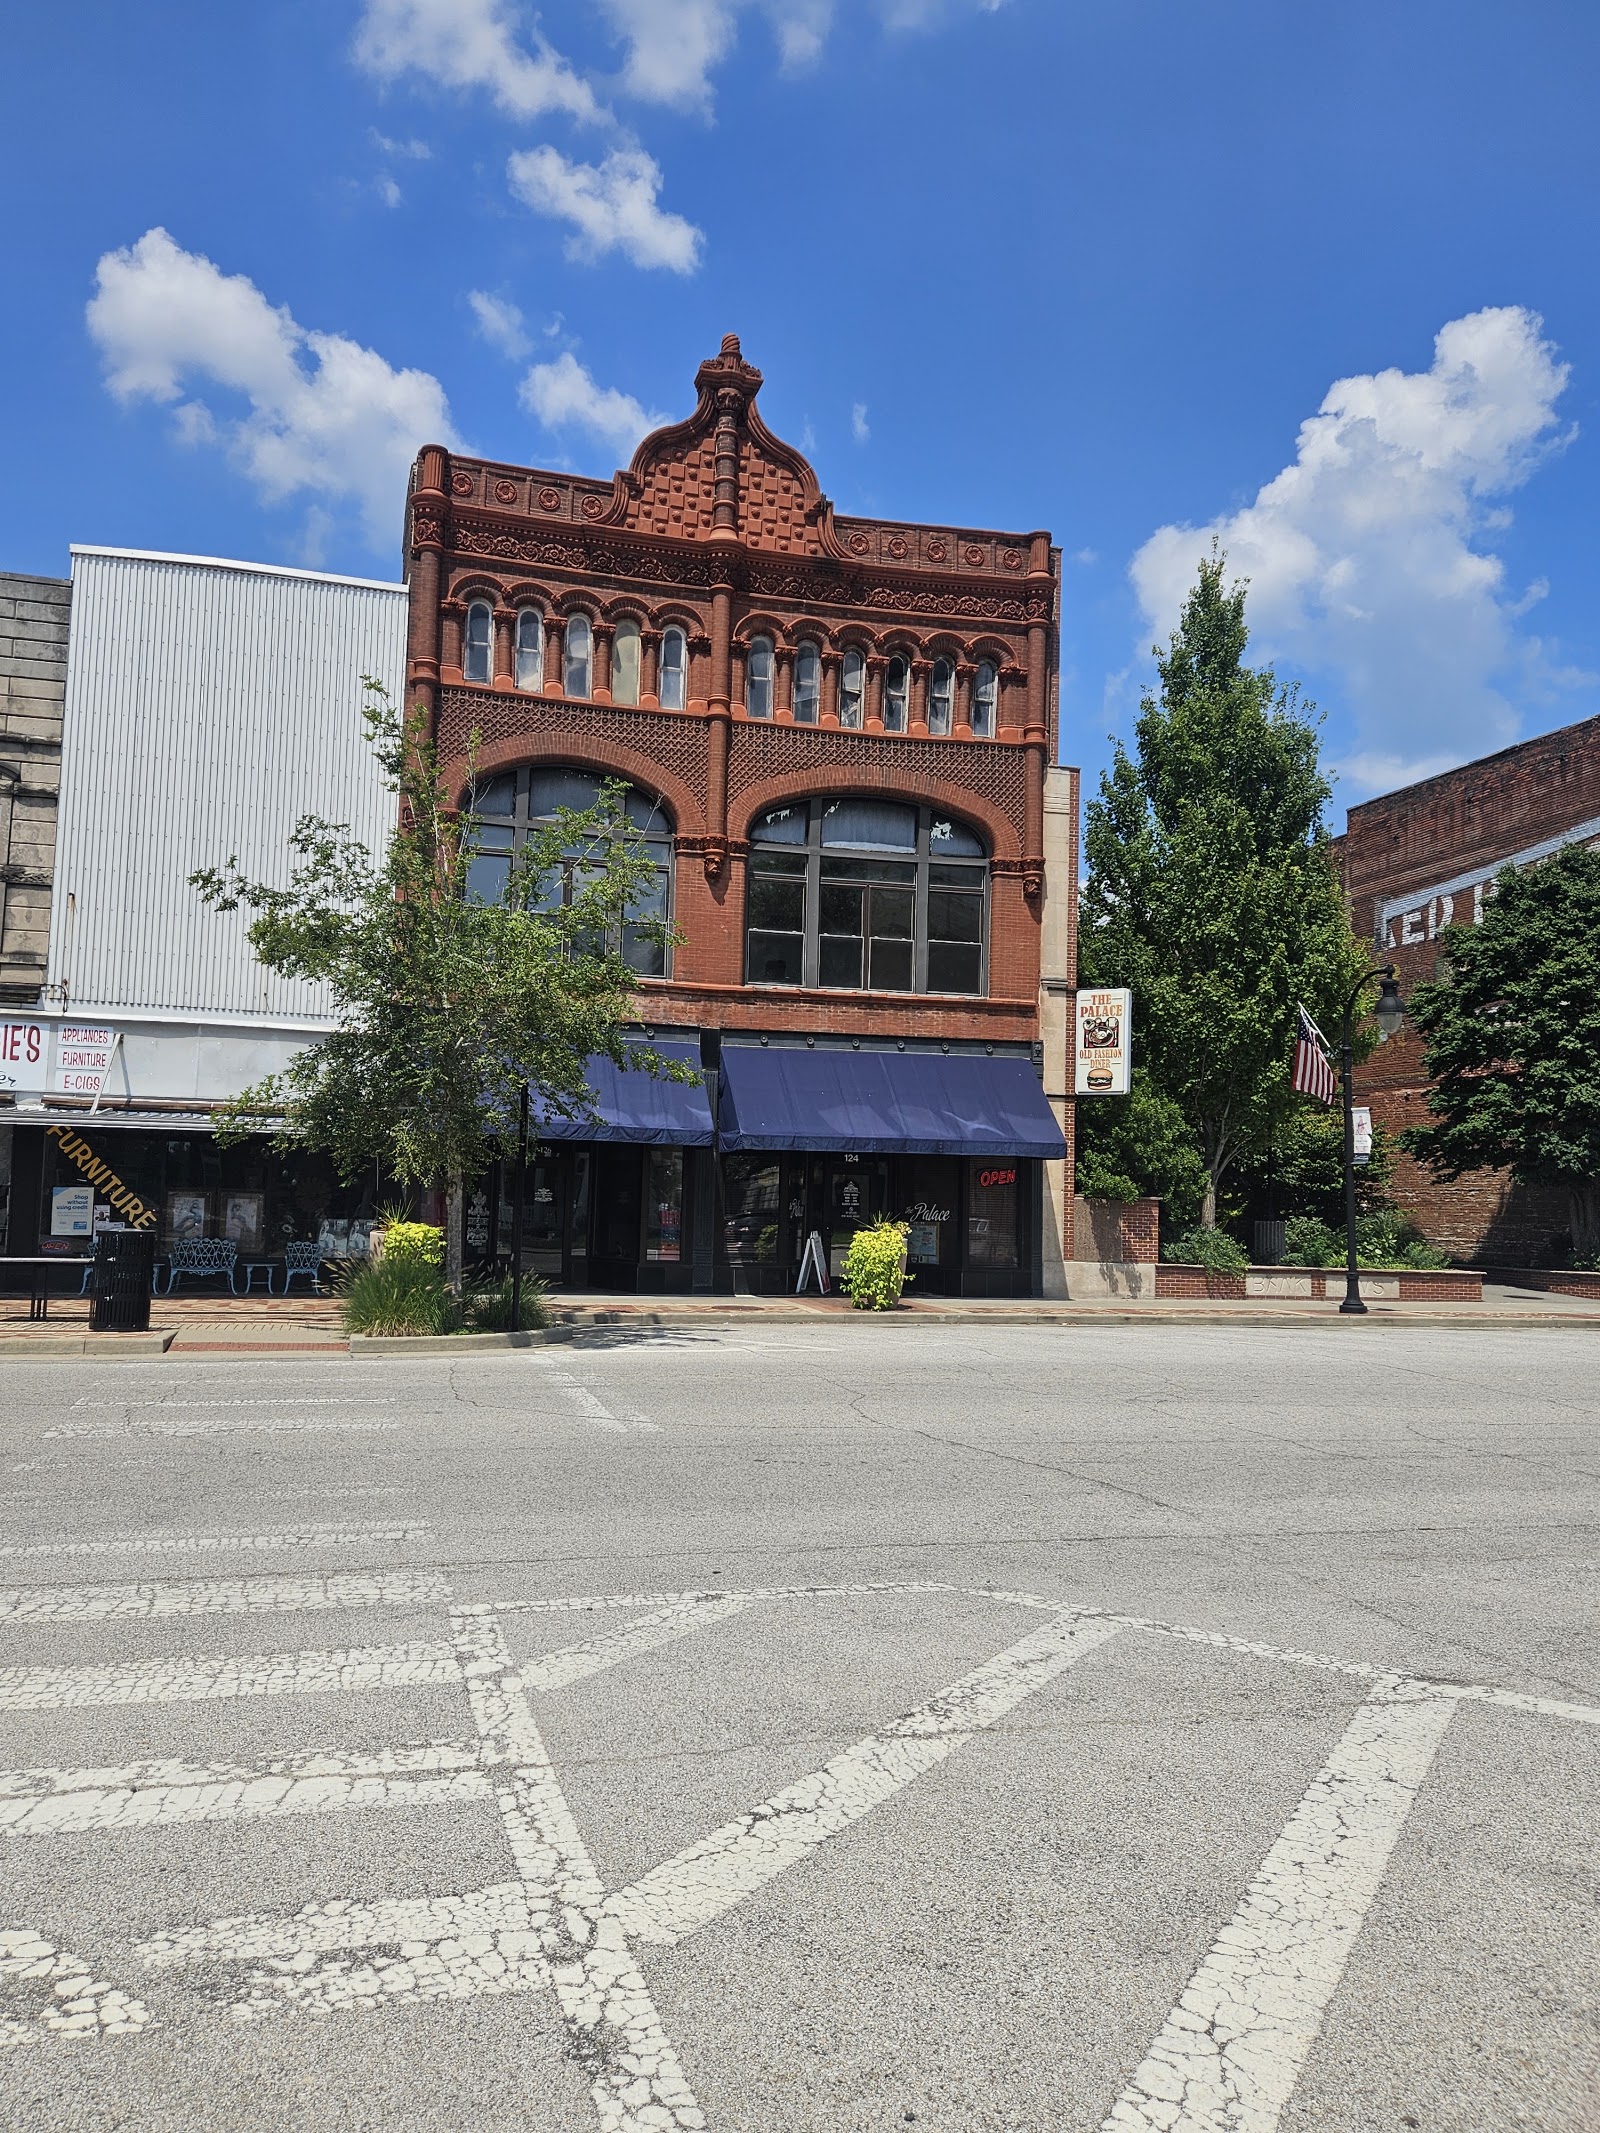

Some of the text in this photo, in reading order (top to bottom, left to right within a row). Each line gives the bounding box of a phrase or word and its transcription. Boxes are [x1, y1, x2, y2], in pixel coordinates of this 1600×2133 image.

[1090, 993, 1112, 1005] THE
[1080, 1004, 1123, 1018] PALACE
[61, 1027, 108, 1044] APPLIANCES
[62, 1051, 107, 1067] FURNITURE
[1079, 1048, 1123, 1059] OLD FASHION
[1090, 1059, 1111, 1069] DINER
[63, 1074, 101, 1091] E-CIGS
[843, 1153, 859, 1163] 124
[45, 1125, 157, 1230] FURNITURE
[980, 1169, 1016, 1187] OPEN
[910, 1202, 951, 1222] Palace
